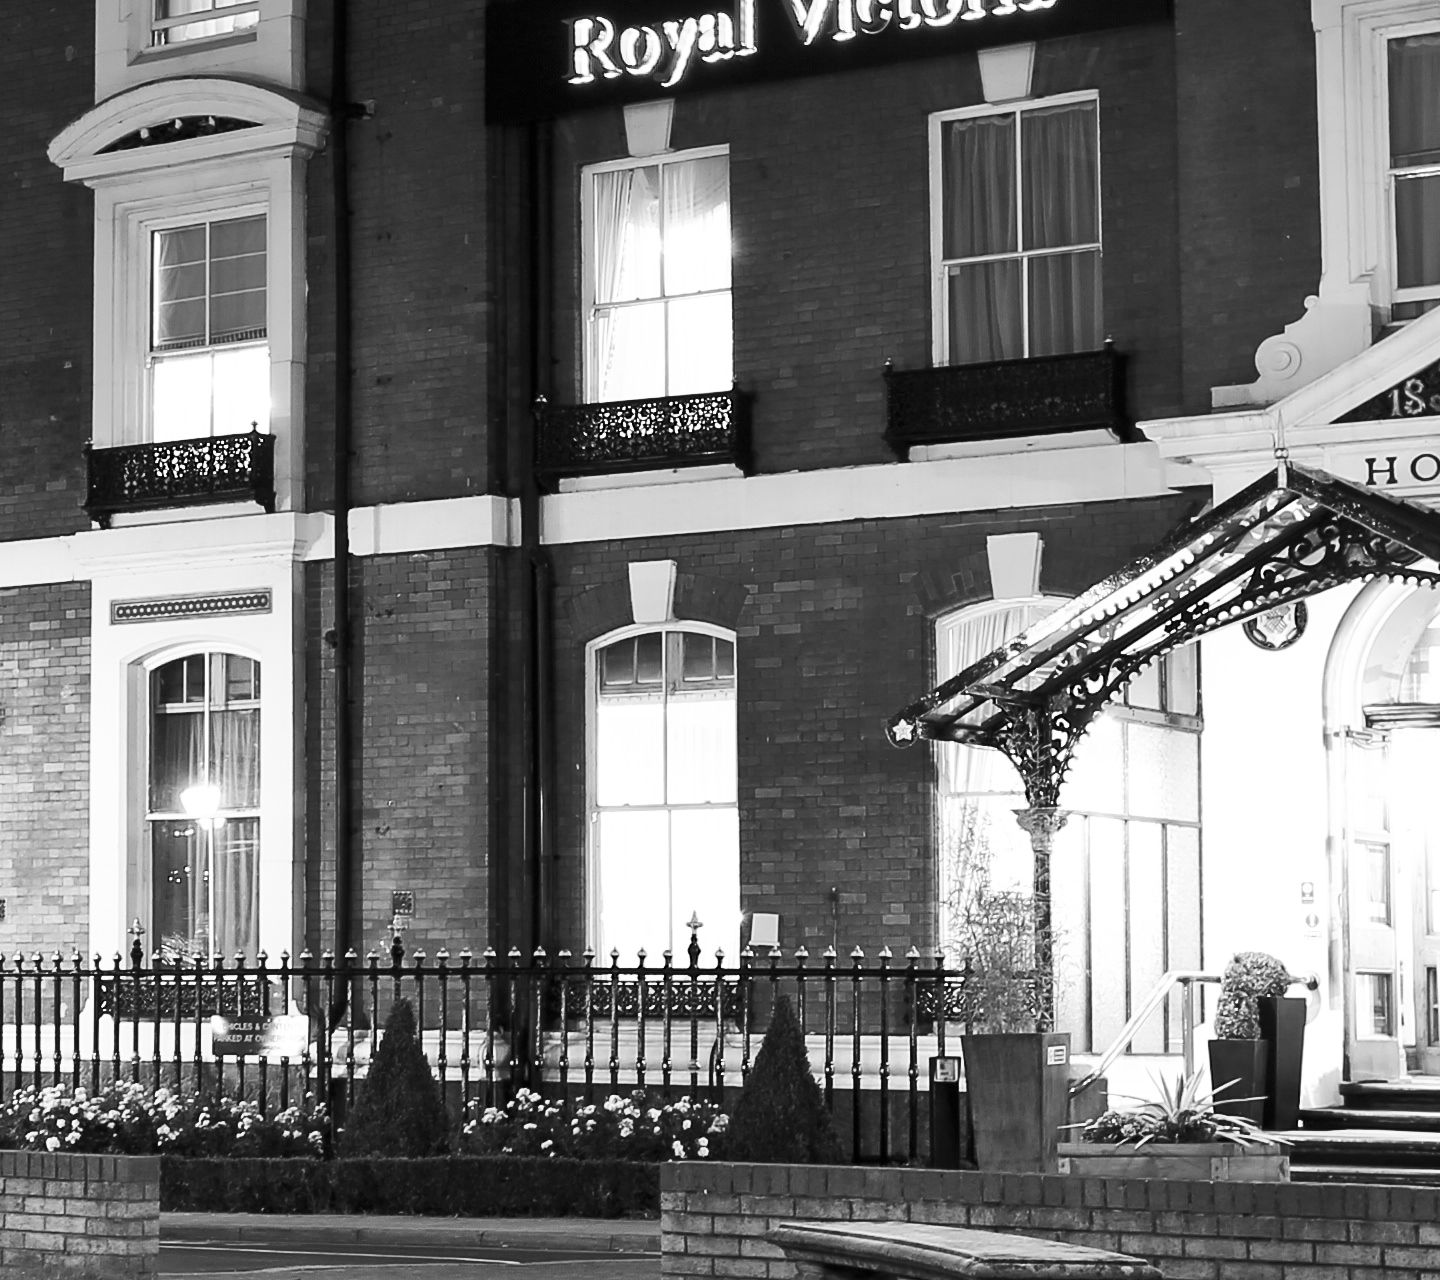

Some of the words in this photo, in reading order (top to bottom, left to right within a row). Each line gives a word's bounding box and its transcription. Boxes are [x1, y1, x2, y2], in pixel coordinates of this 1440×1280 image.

[217, 1022, 253, 1031] HICLES
[214, 1034, 243, 1043] PAKED
[243, 1034, 254, 1043] AT
